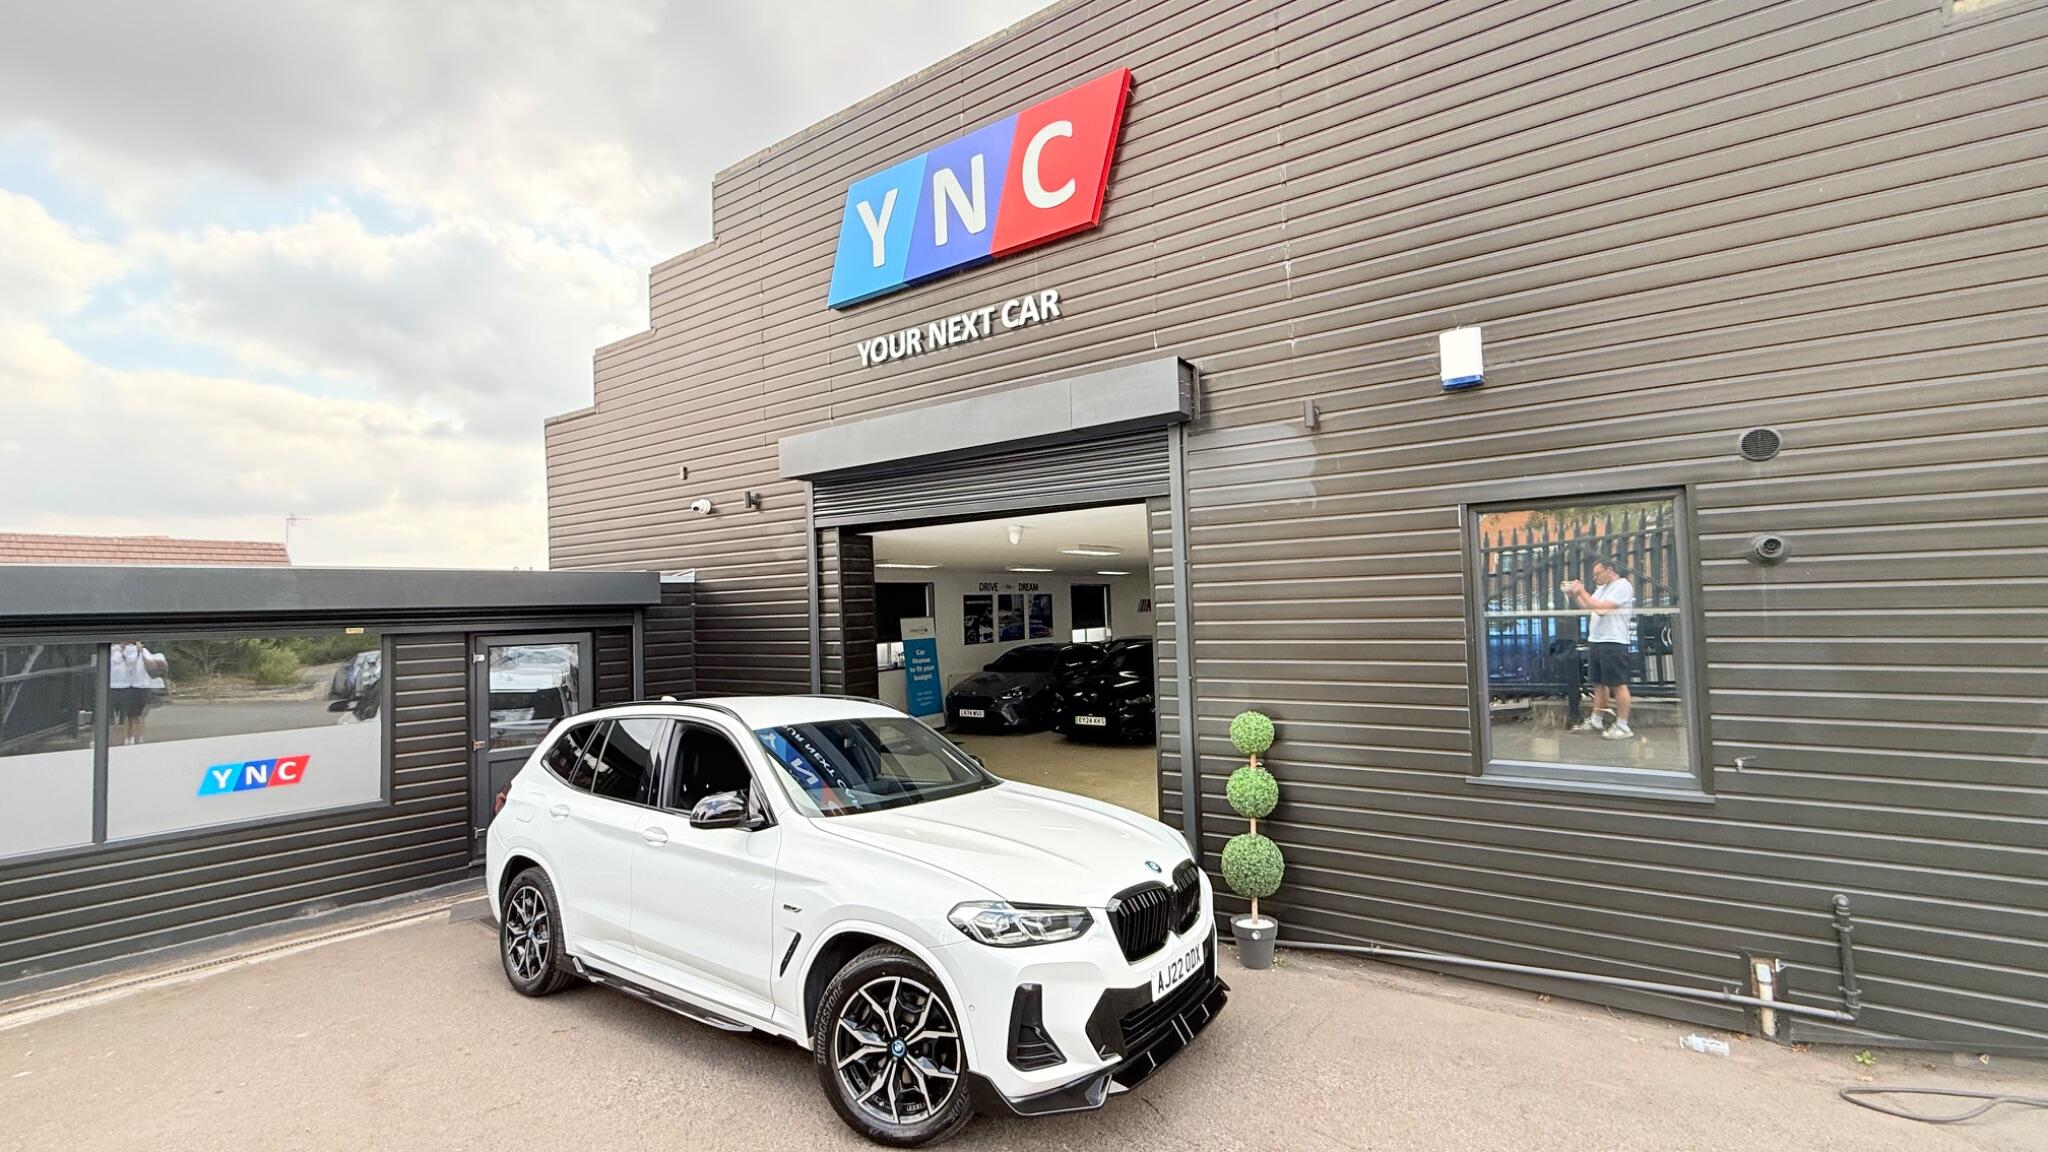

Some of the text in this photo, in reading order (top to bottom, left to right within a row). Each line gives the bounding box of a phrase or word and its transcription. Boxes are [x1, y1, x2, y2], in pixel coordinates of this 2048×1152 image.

[856, 120, 1076, 268] YNC
[857, 288, 1061, 367] YOUR NEXT CAR
[979, 582, 999, 592] DRIVE
[1018, 582, 1039, 592] DREAM
[212, 761, 297, 789] YNC
[1158, 958, 1184, 993] AJ22
[817, 982, 845, 1066] BRIDGESTONE
